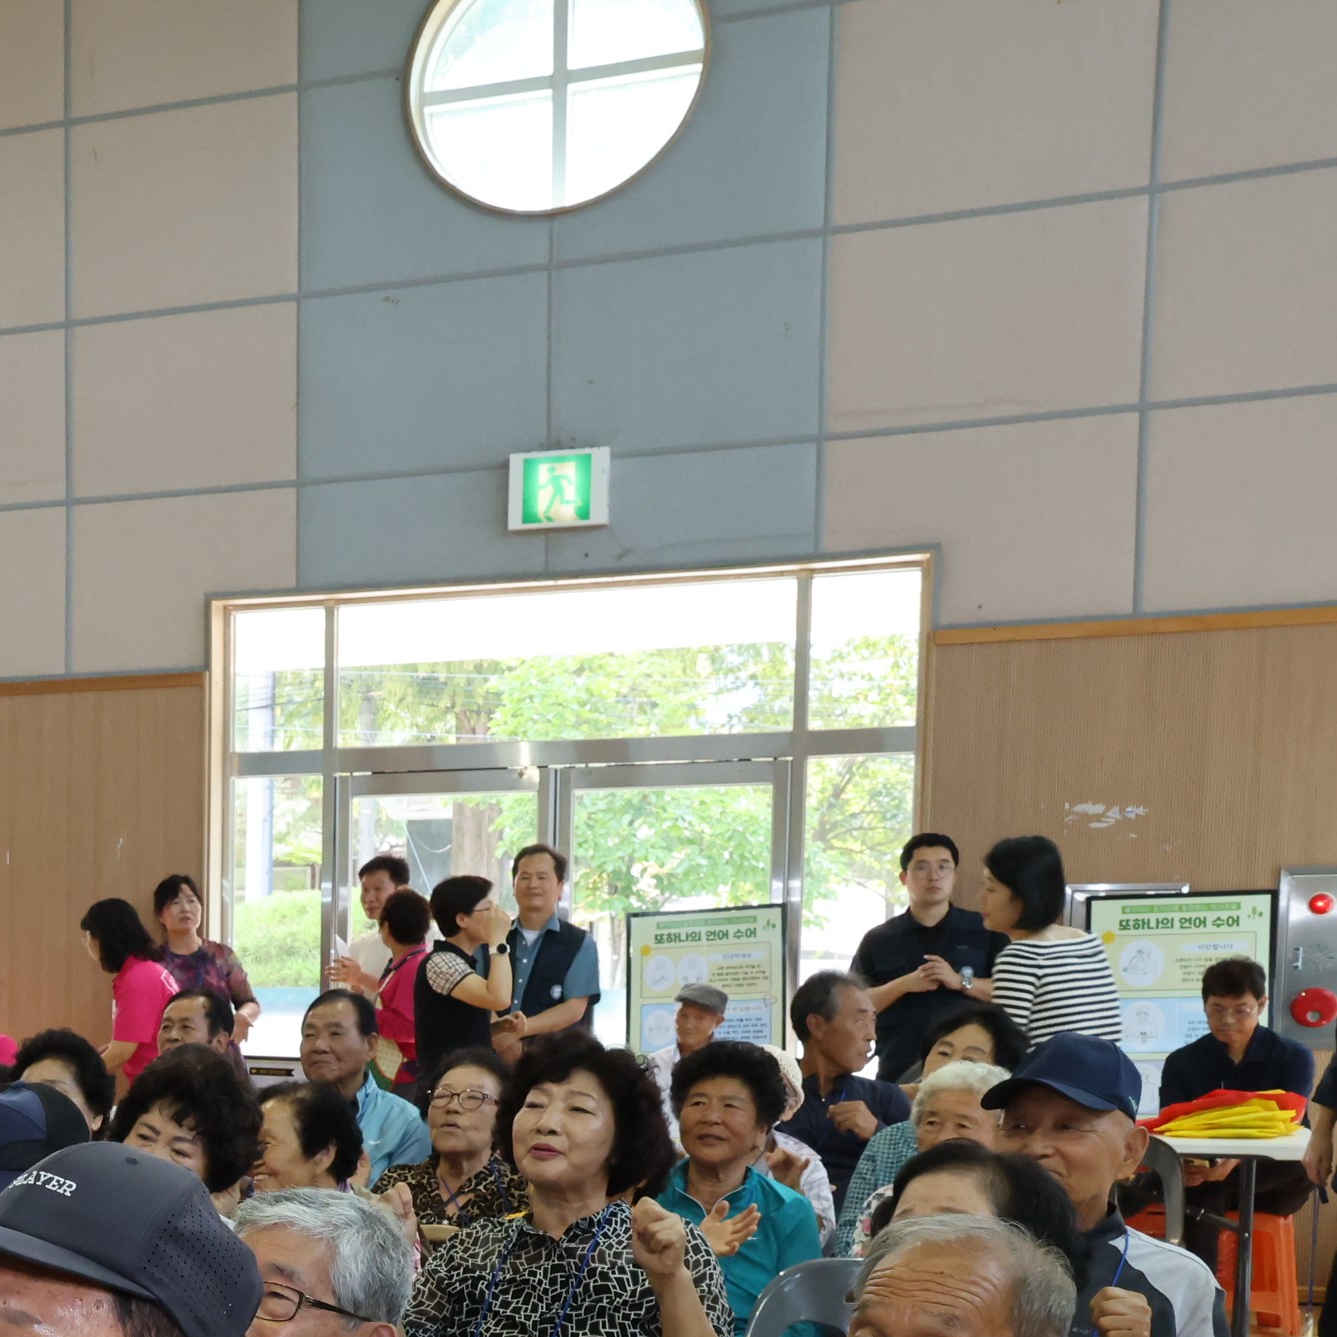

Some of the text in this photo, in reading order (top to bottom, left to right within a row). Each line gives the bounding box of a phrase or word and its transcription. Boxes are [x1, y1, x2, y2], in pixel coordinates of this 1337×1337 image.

[1118, 915, 1240, 931] 또하나의 언어 수어
[654, 927, 757, 945] 또하나의 언어 수어
